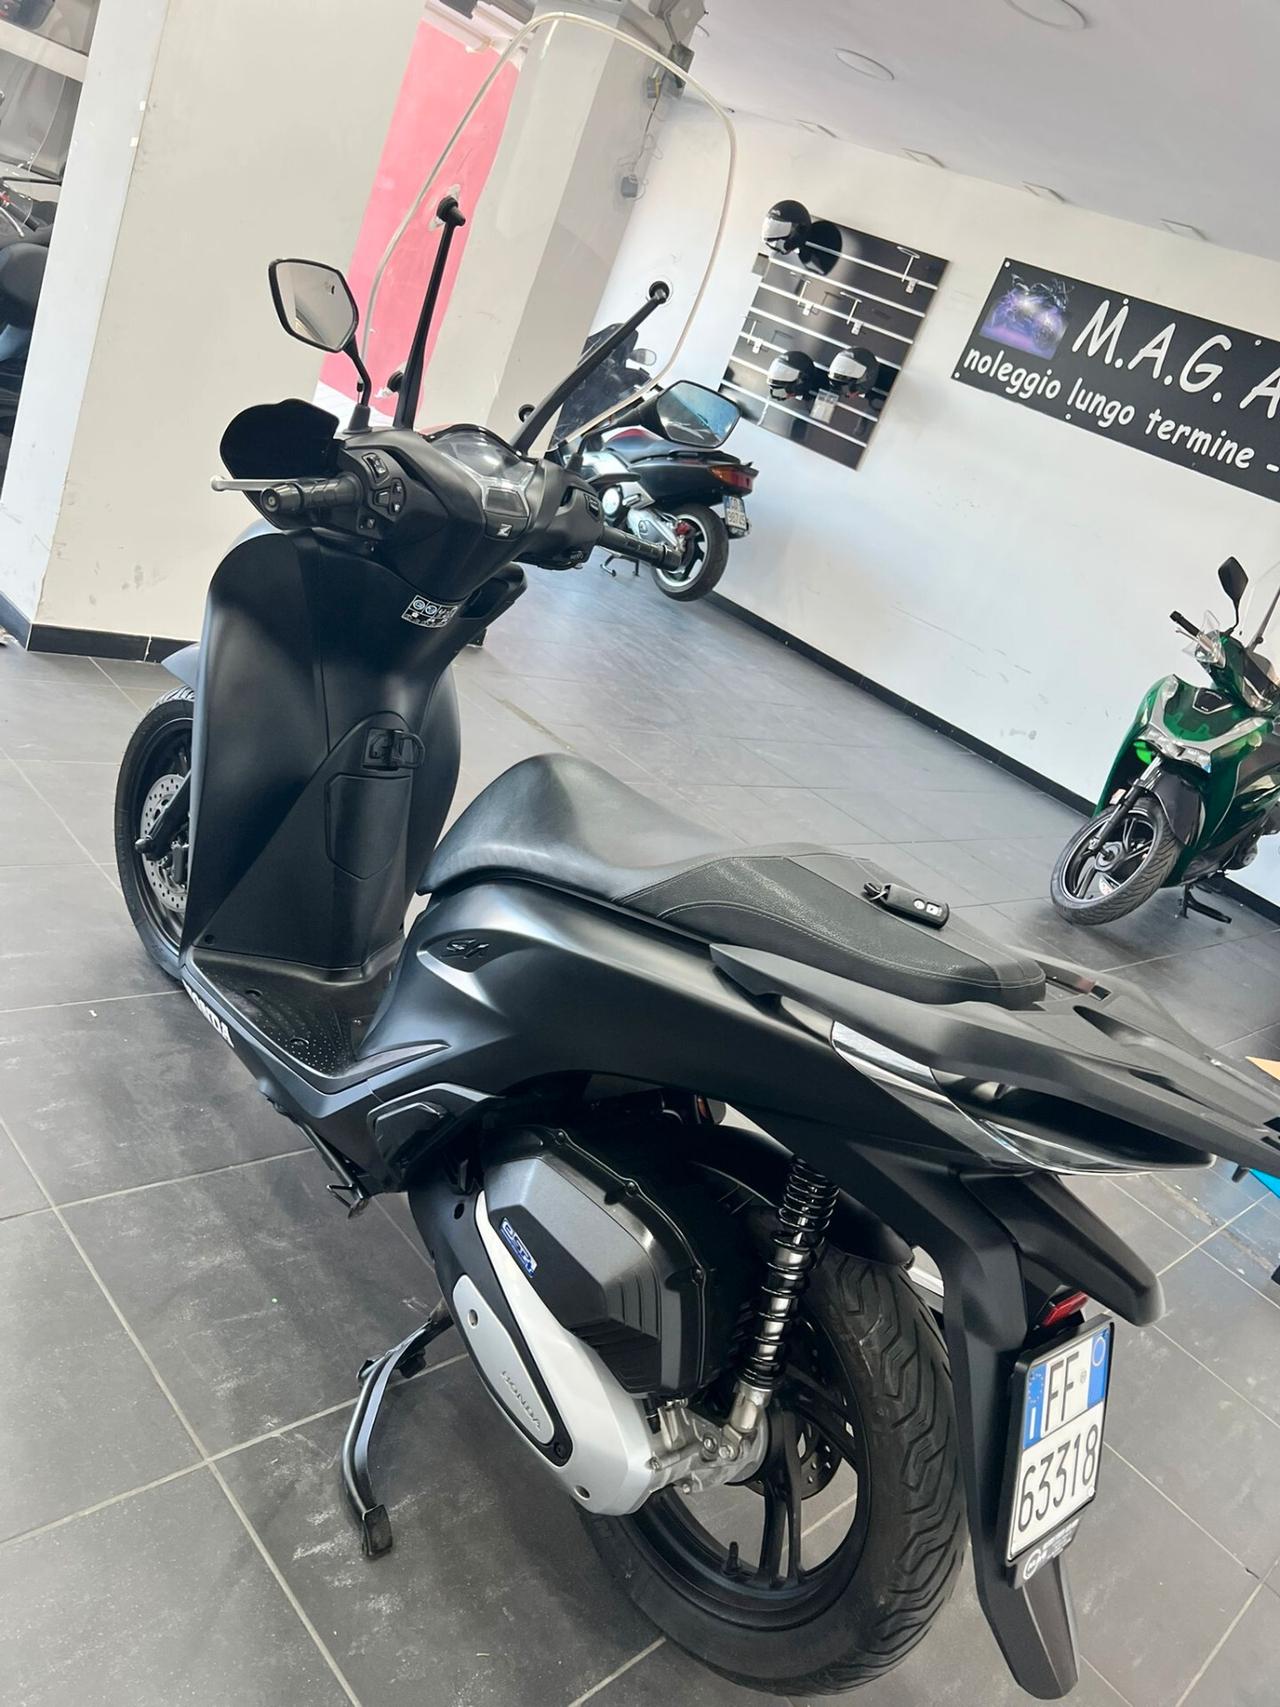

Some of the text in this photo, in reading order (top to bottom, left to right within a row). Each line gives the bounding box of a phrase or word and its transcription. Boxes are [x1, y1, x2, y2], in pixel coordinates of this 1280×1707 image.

[1072, 299, 1232, 403] M.A.G.
[963, 347, 1062, 399] noleggio
[1066, 377, 1136, 428] lungo
[1145, 408, 1255, 469] termine
[500, 1370, 542, 1431] HONDA
[1044, 1350, 1080, 1433] FF
[1017, 1423, 1099, 1533] 63318
